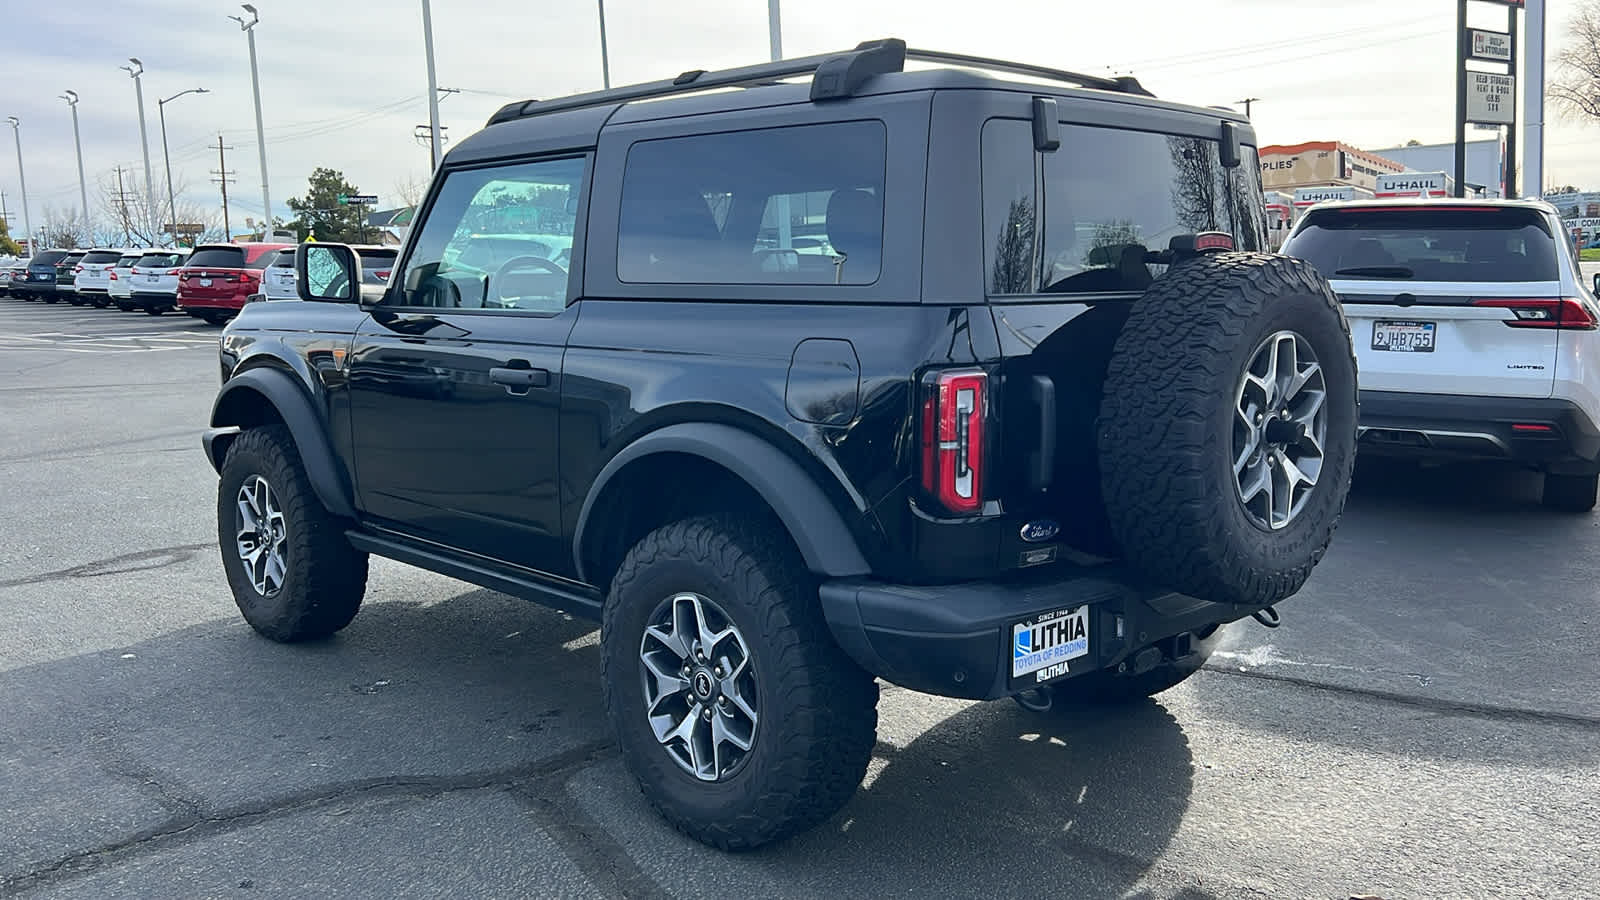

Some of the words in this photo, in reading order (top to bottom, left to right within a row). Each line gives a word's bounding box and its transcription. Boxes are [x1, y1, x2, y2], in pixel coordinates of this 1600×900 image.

[1485, 45, 1509, 56] STORAGE
[1476, 74, 1488, 83] NEED
[1477, 84, 1489, 93] RENT
[1260, 160, 1293, 171] PLIES
[1384, 180, 1439, 191] U-HAUL
[1302, 193, 1345, 201] U-HAUL
[1581, 219, 1600, 227] COM
[1376, 331, 1430, 347] 9JHB755
[1038, 613, 1055, 622] SINCE
[1056, 609, 1068, 618] 1946
[1032, 615, 1086, 652] LITHIA
[1015, 654, 1042, 671] TOYOTA
[1043, 649, 1053, 661] OF
[1054, 639, 1087, 657] REDDING
[1044, 661, 1070, 680] LITHIA
